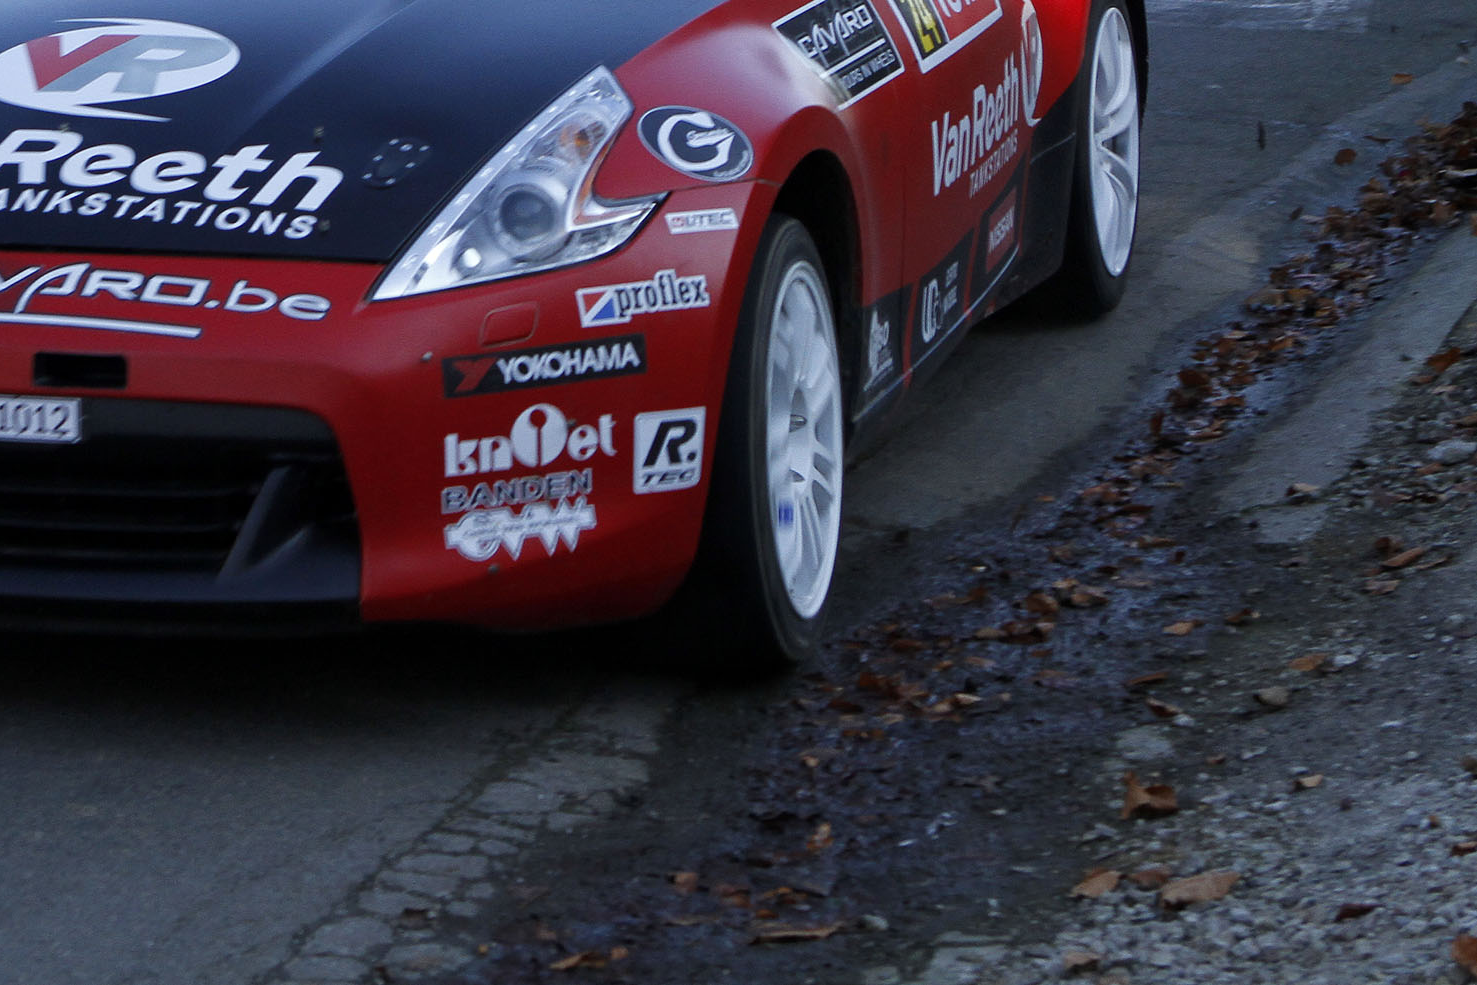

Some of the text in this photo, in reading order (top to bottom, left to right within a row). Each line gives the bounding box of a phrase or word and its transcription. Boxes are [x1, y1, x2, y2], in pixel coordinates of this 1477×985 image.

[797, 4, 873, 69] CAVARO
[26, 33, 236, 93] VR
[931, 111, 971, 197] Van
[970, 51, 1019, 167] Reeth
[615, 273, 706, 318] proflex
[496, 341, 642, 385] YOKOHAMA
[441, 468, 594, 514] BANDEN
[643, 468, 696, 485] TEC
